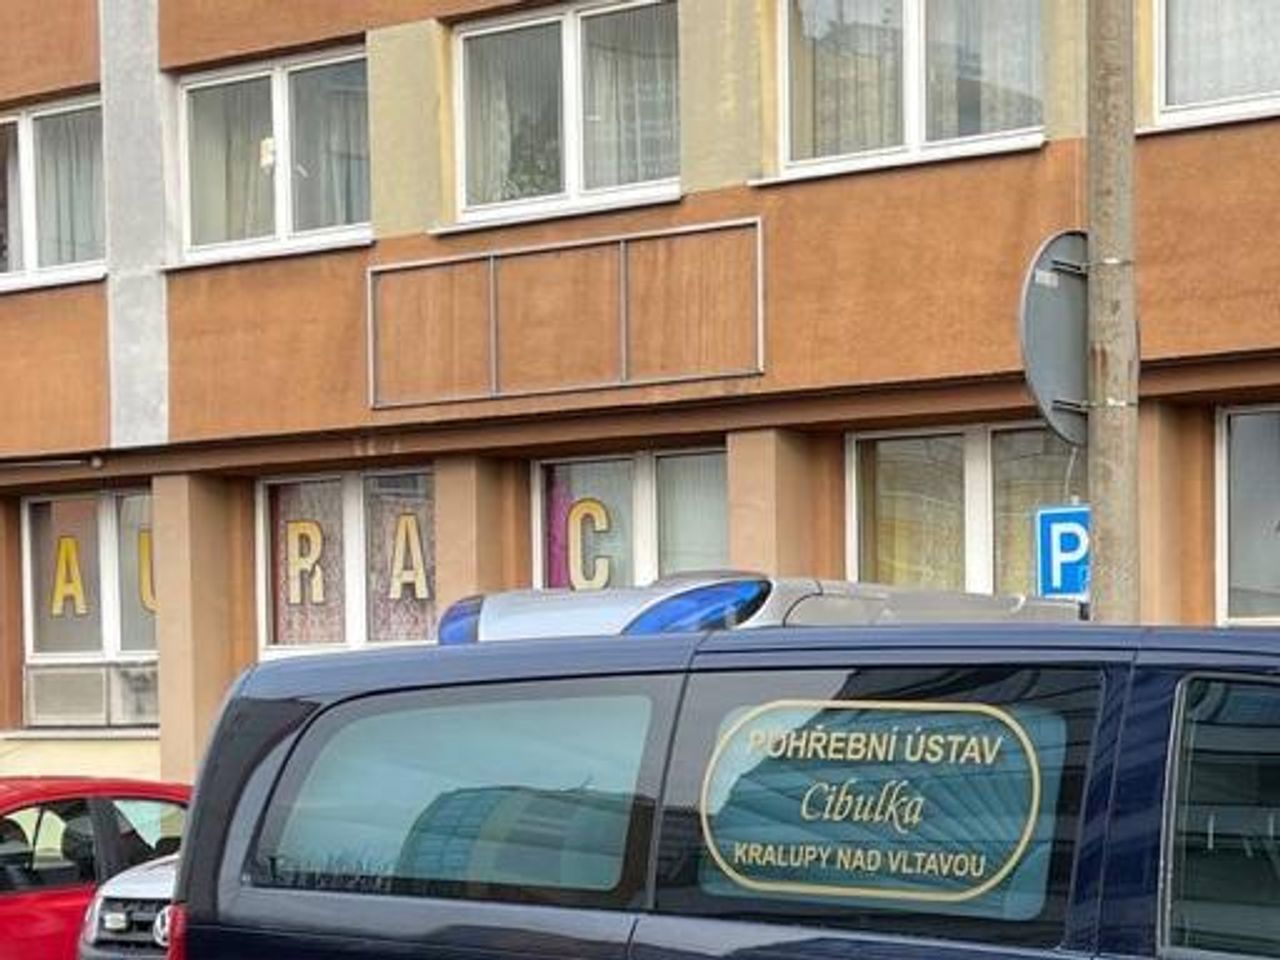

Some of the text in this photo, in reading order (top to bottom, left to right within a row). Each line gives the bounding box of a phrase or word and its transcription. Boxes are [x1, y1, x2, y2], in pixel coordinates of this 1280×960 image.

[1050, 522, 1089, 588] P
[749, 724, 1003, 765] POHŘEBNÍ ÚSTAV
[801, 780, 926, 834] Cibulka
[734, 842, 987, 878] KRALUPY NAD VLTAVOU
